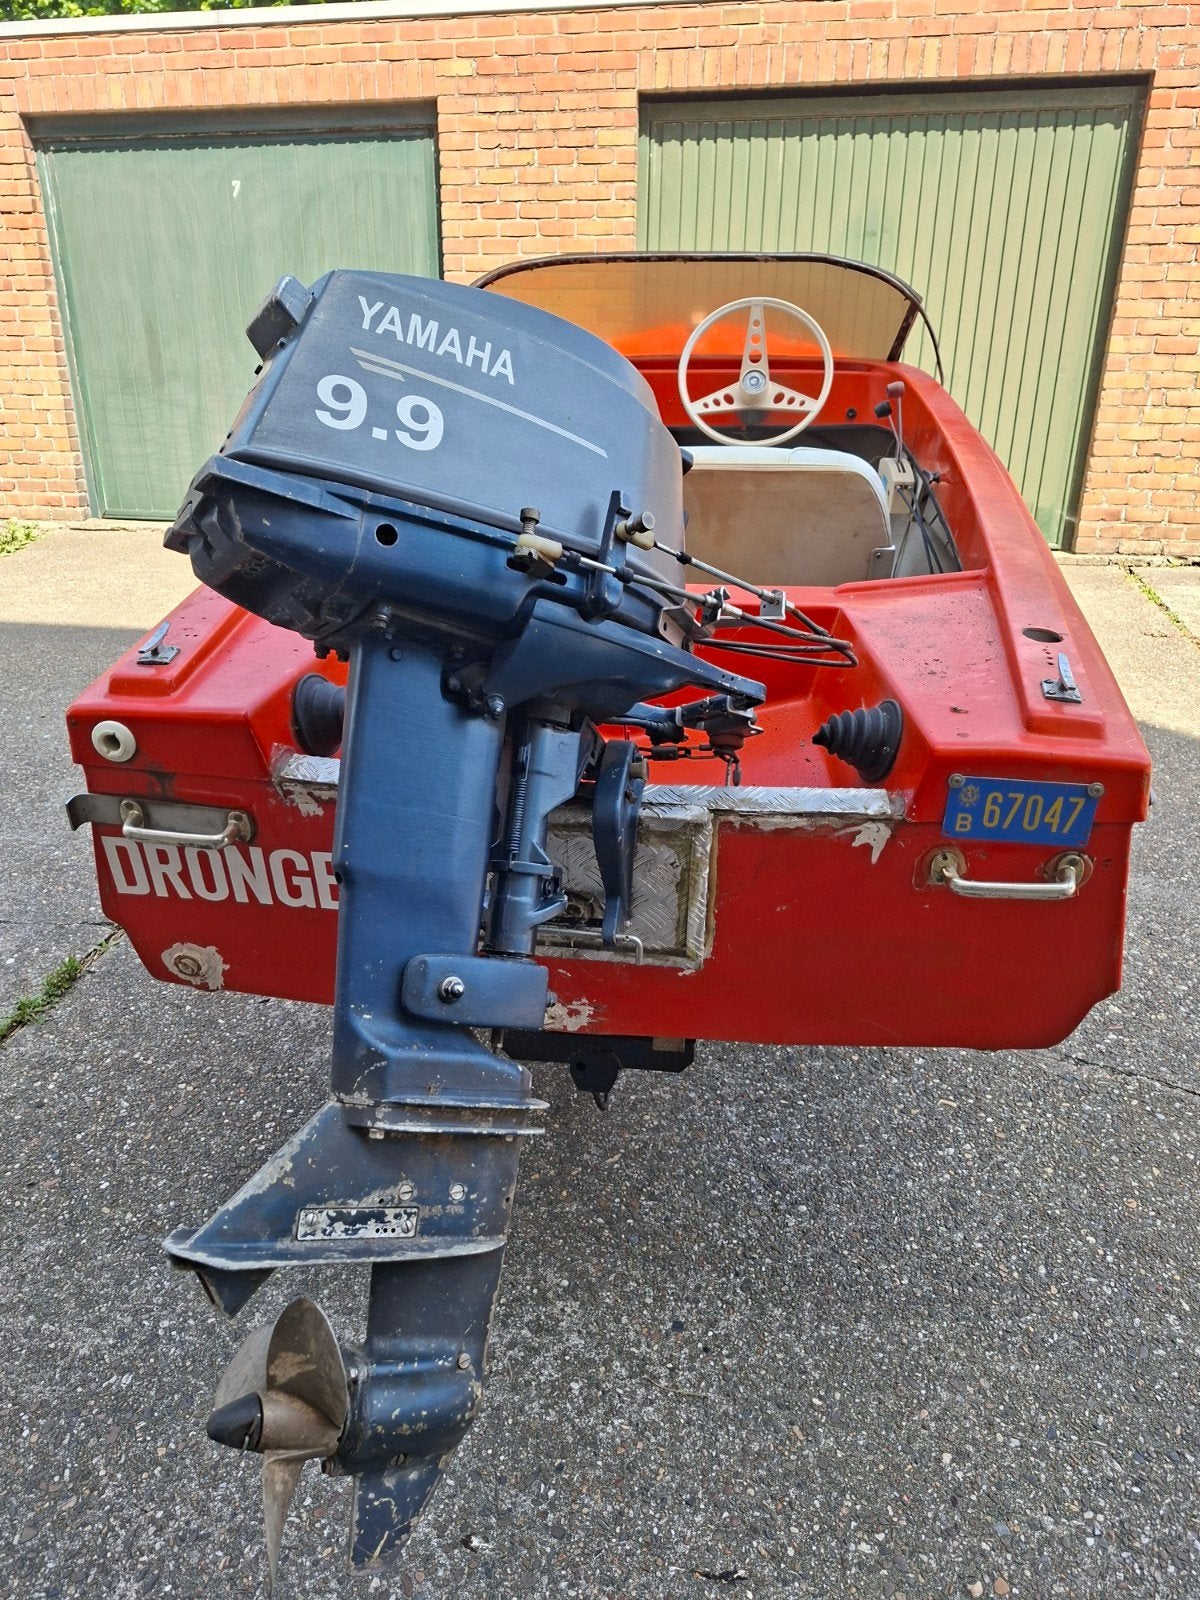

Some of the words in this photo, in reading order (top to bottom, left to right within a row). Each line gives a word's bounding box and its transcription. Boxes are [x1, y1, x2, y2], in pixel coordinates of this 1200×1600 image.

[231, 179, 241, 199] 7
[357, 294, 516, 386] YAMAHA
[314, 373, 446, 452] 9.9
[955, 813, 973, 832] B
[982, 791, 1086, 834] 67047
